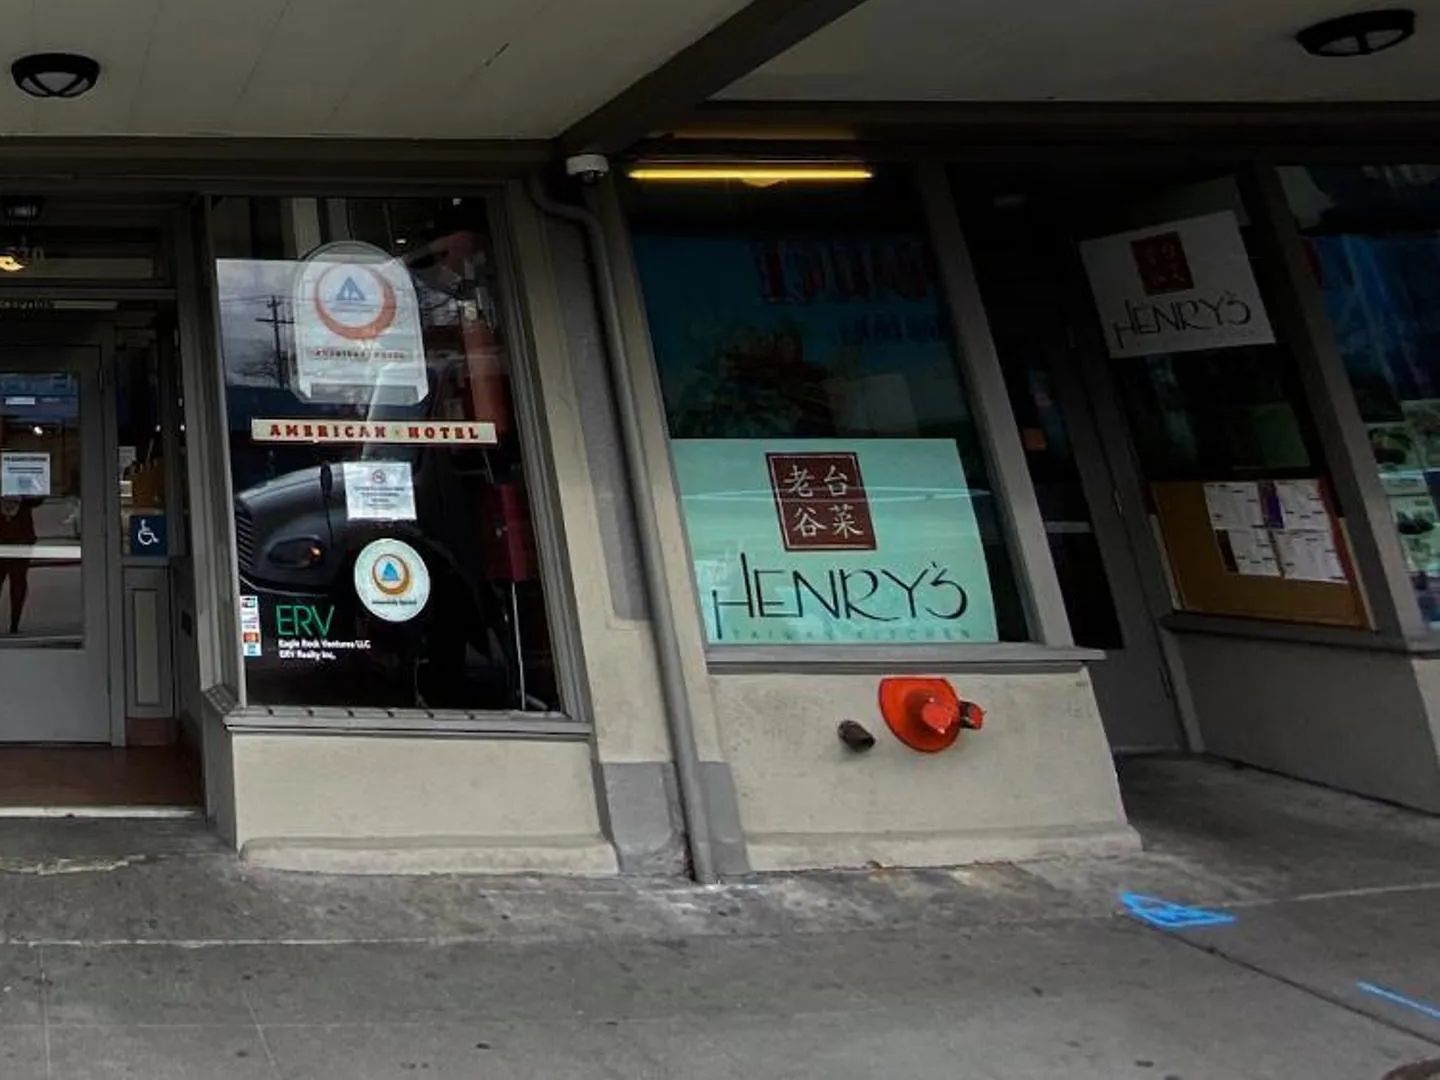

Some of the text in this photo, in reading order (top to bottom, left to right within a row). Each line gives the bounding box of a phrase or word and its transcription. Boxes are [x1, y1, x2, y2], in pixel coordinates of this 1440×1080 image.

[269, 424, 479, 440] AMERICAN HOTEL
[711, 552, 968, 640] HENRY'S
[275, 604, 336, 636] ERV
